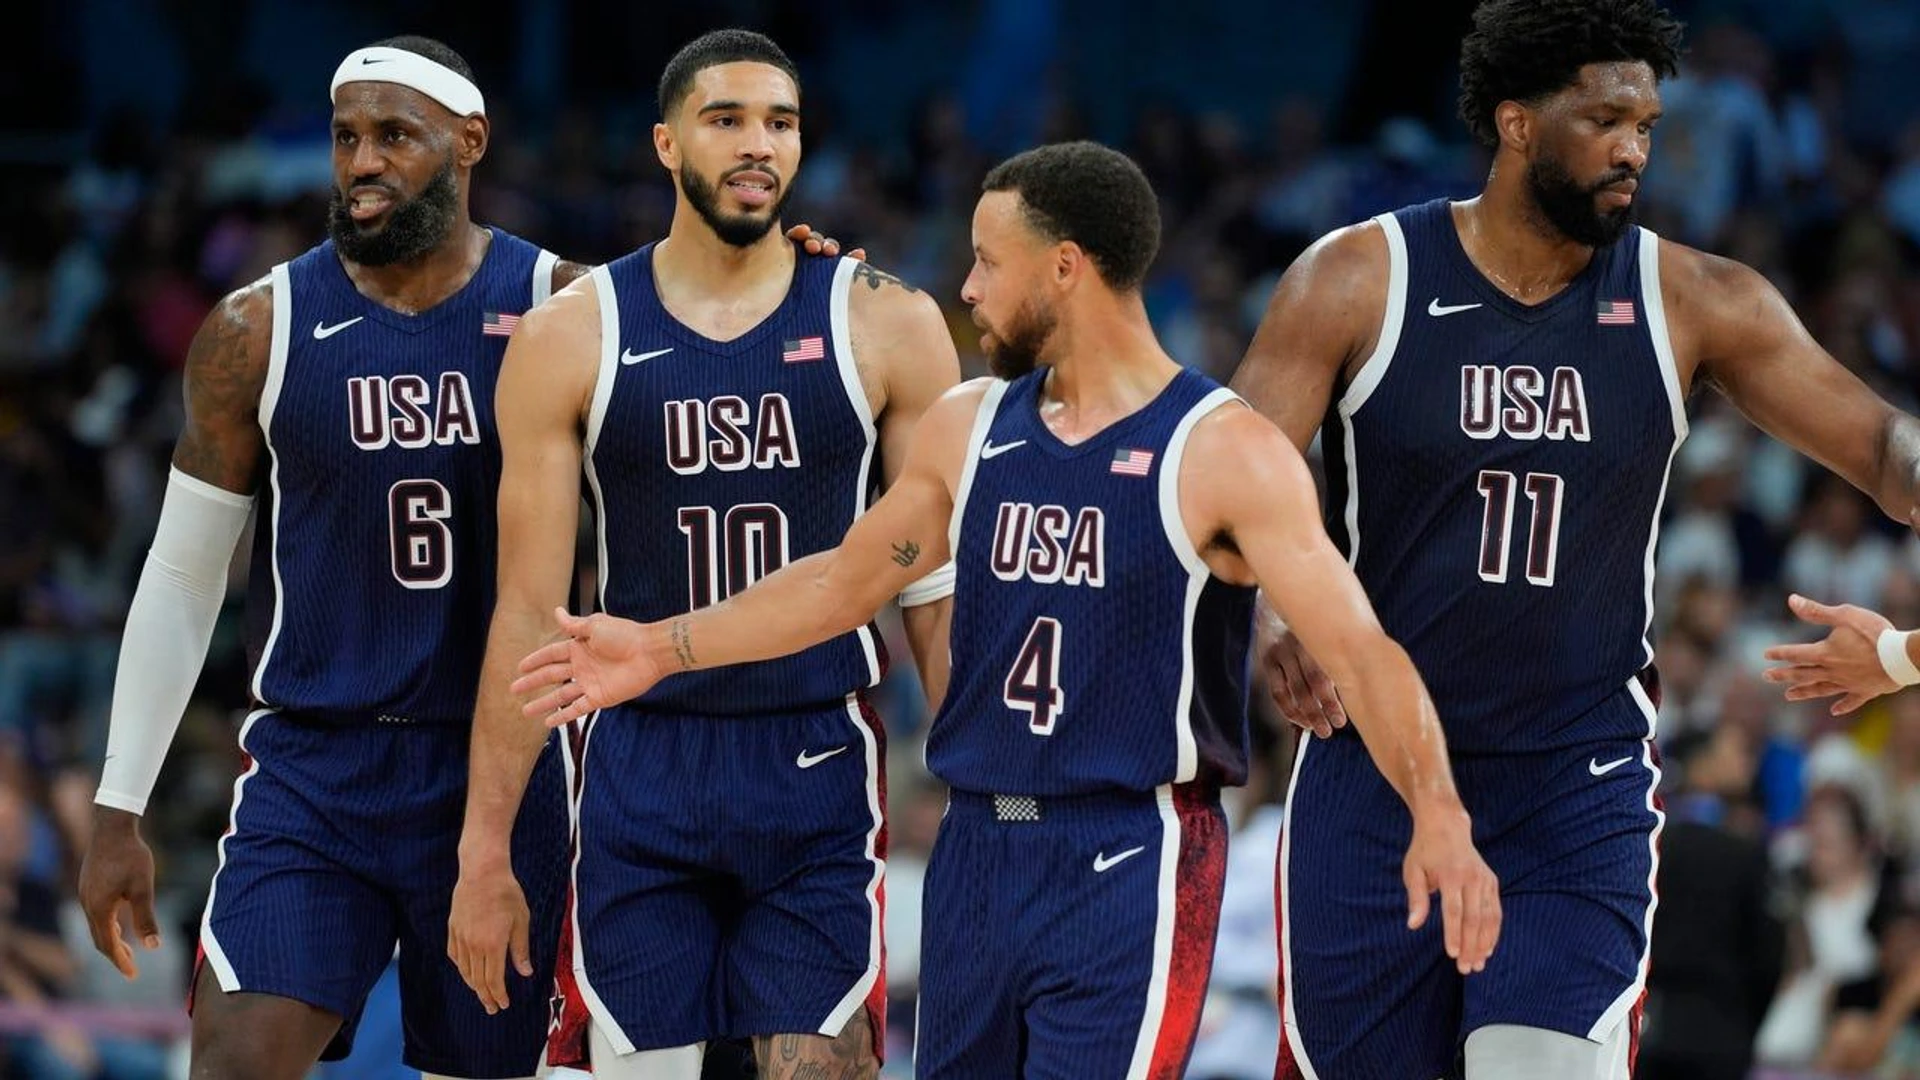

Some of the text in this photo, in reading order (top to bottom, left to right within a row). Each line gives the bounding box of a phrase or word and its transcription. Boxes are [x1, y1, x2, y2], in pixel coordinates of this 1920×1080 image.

[347, 371, 481, 450] USA
[664, 393, 800, 475] USA
[1460, 365, 1591, 442] USA
[388, 478, 453, 589] 6
[677, 503, 790, 612] 10
[991, 502, 1105, 588] USA
[1477, 470, 1565, 587] 11
[1003, 616, 1064, 736] 4
